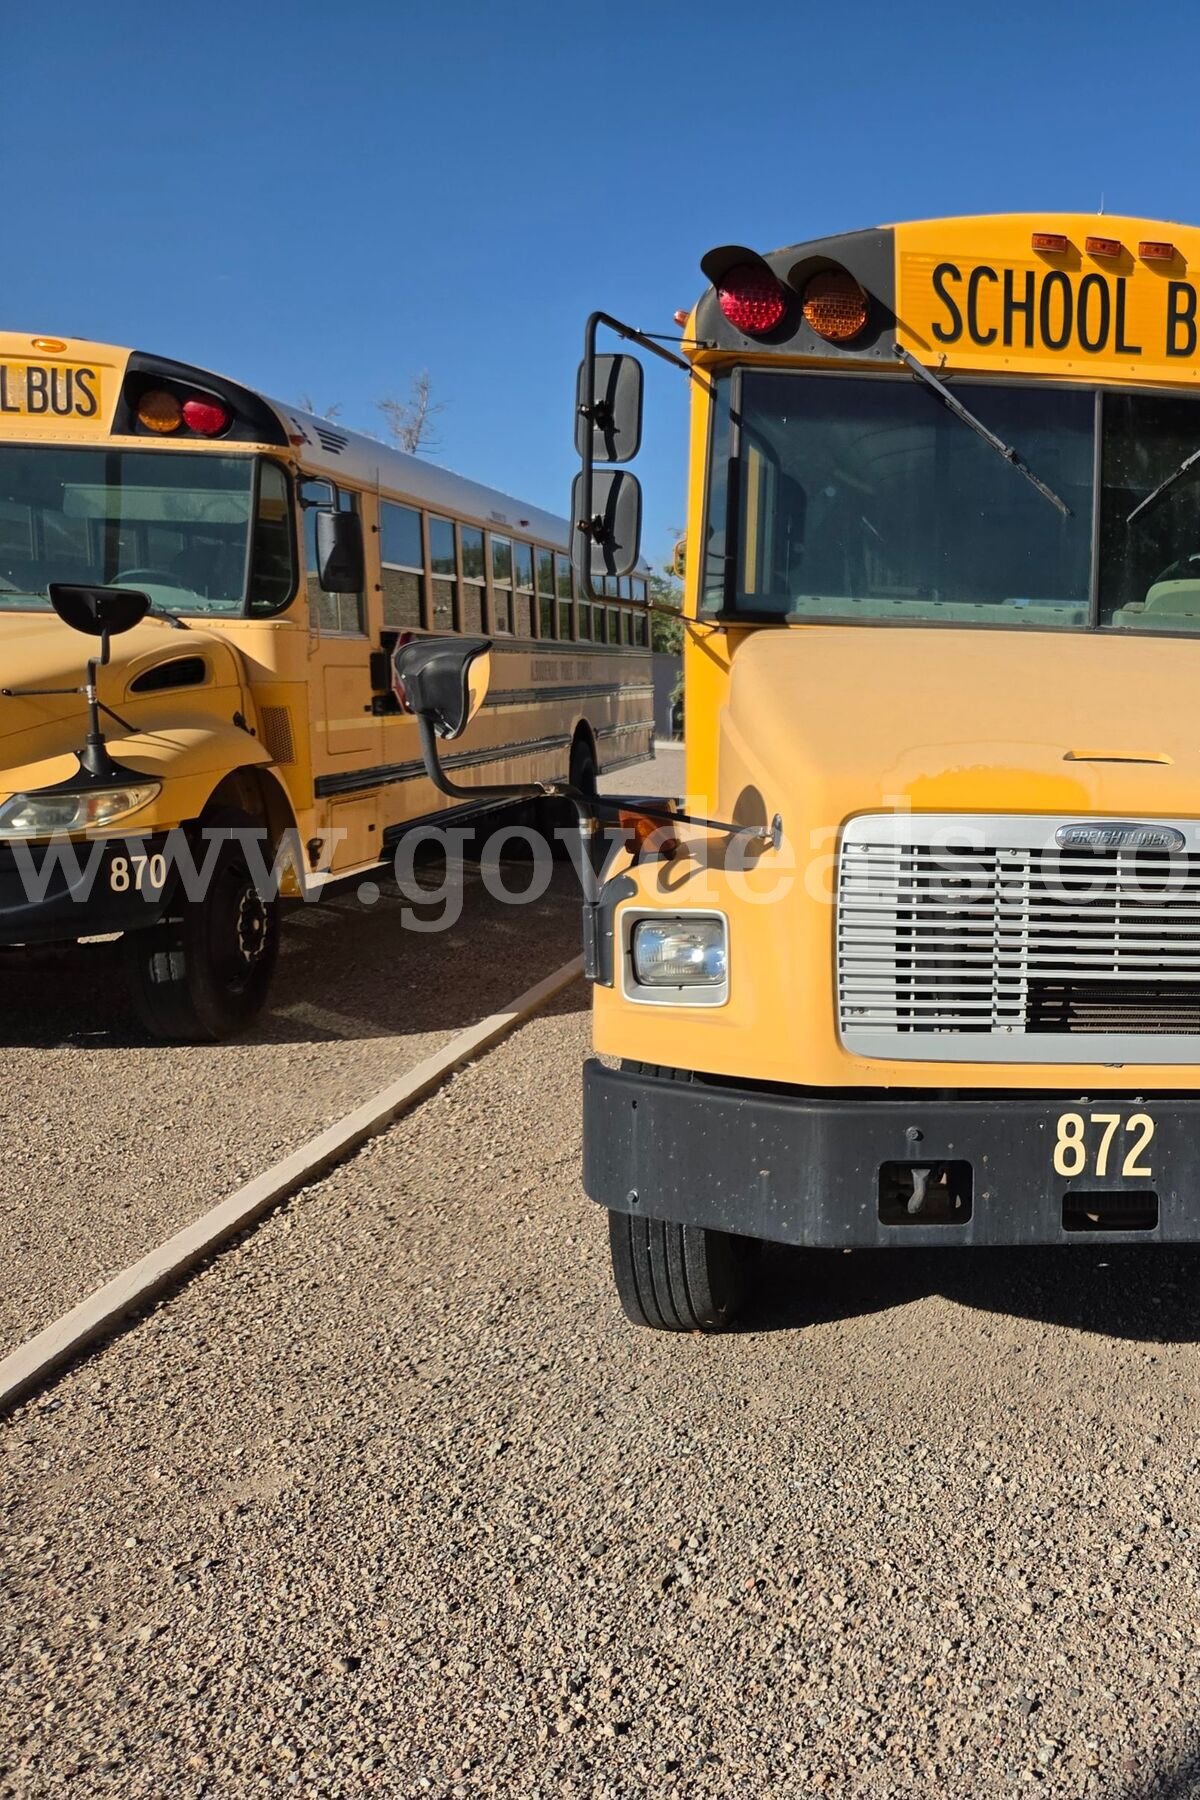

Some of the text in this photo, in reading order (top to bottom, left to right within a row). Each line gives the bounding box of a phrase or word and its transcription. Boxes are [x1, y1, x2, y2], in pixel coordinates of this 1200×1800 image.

[931, 262, 1142, 355] SCHOOL
[26, 366, 97, 417] BUS
[1071, 830, 1169, 846] FREIGHTLINER
[110, 853, 166, 892] 870
[1053, 1112, 1155, 1177] 872
